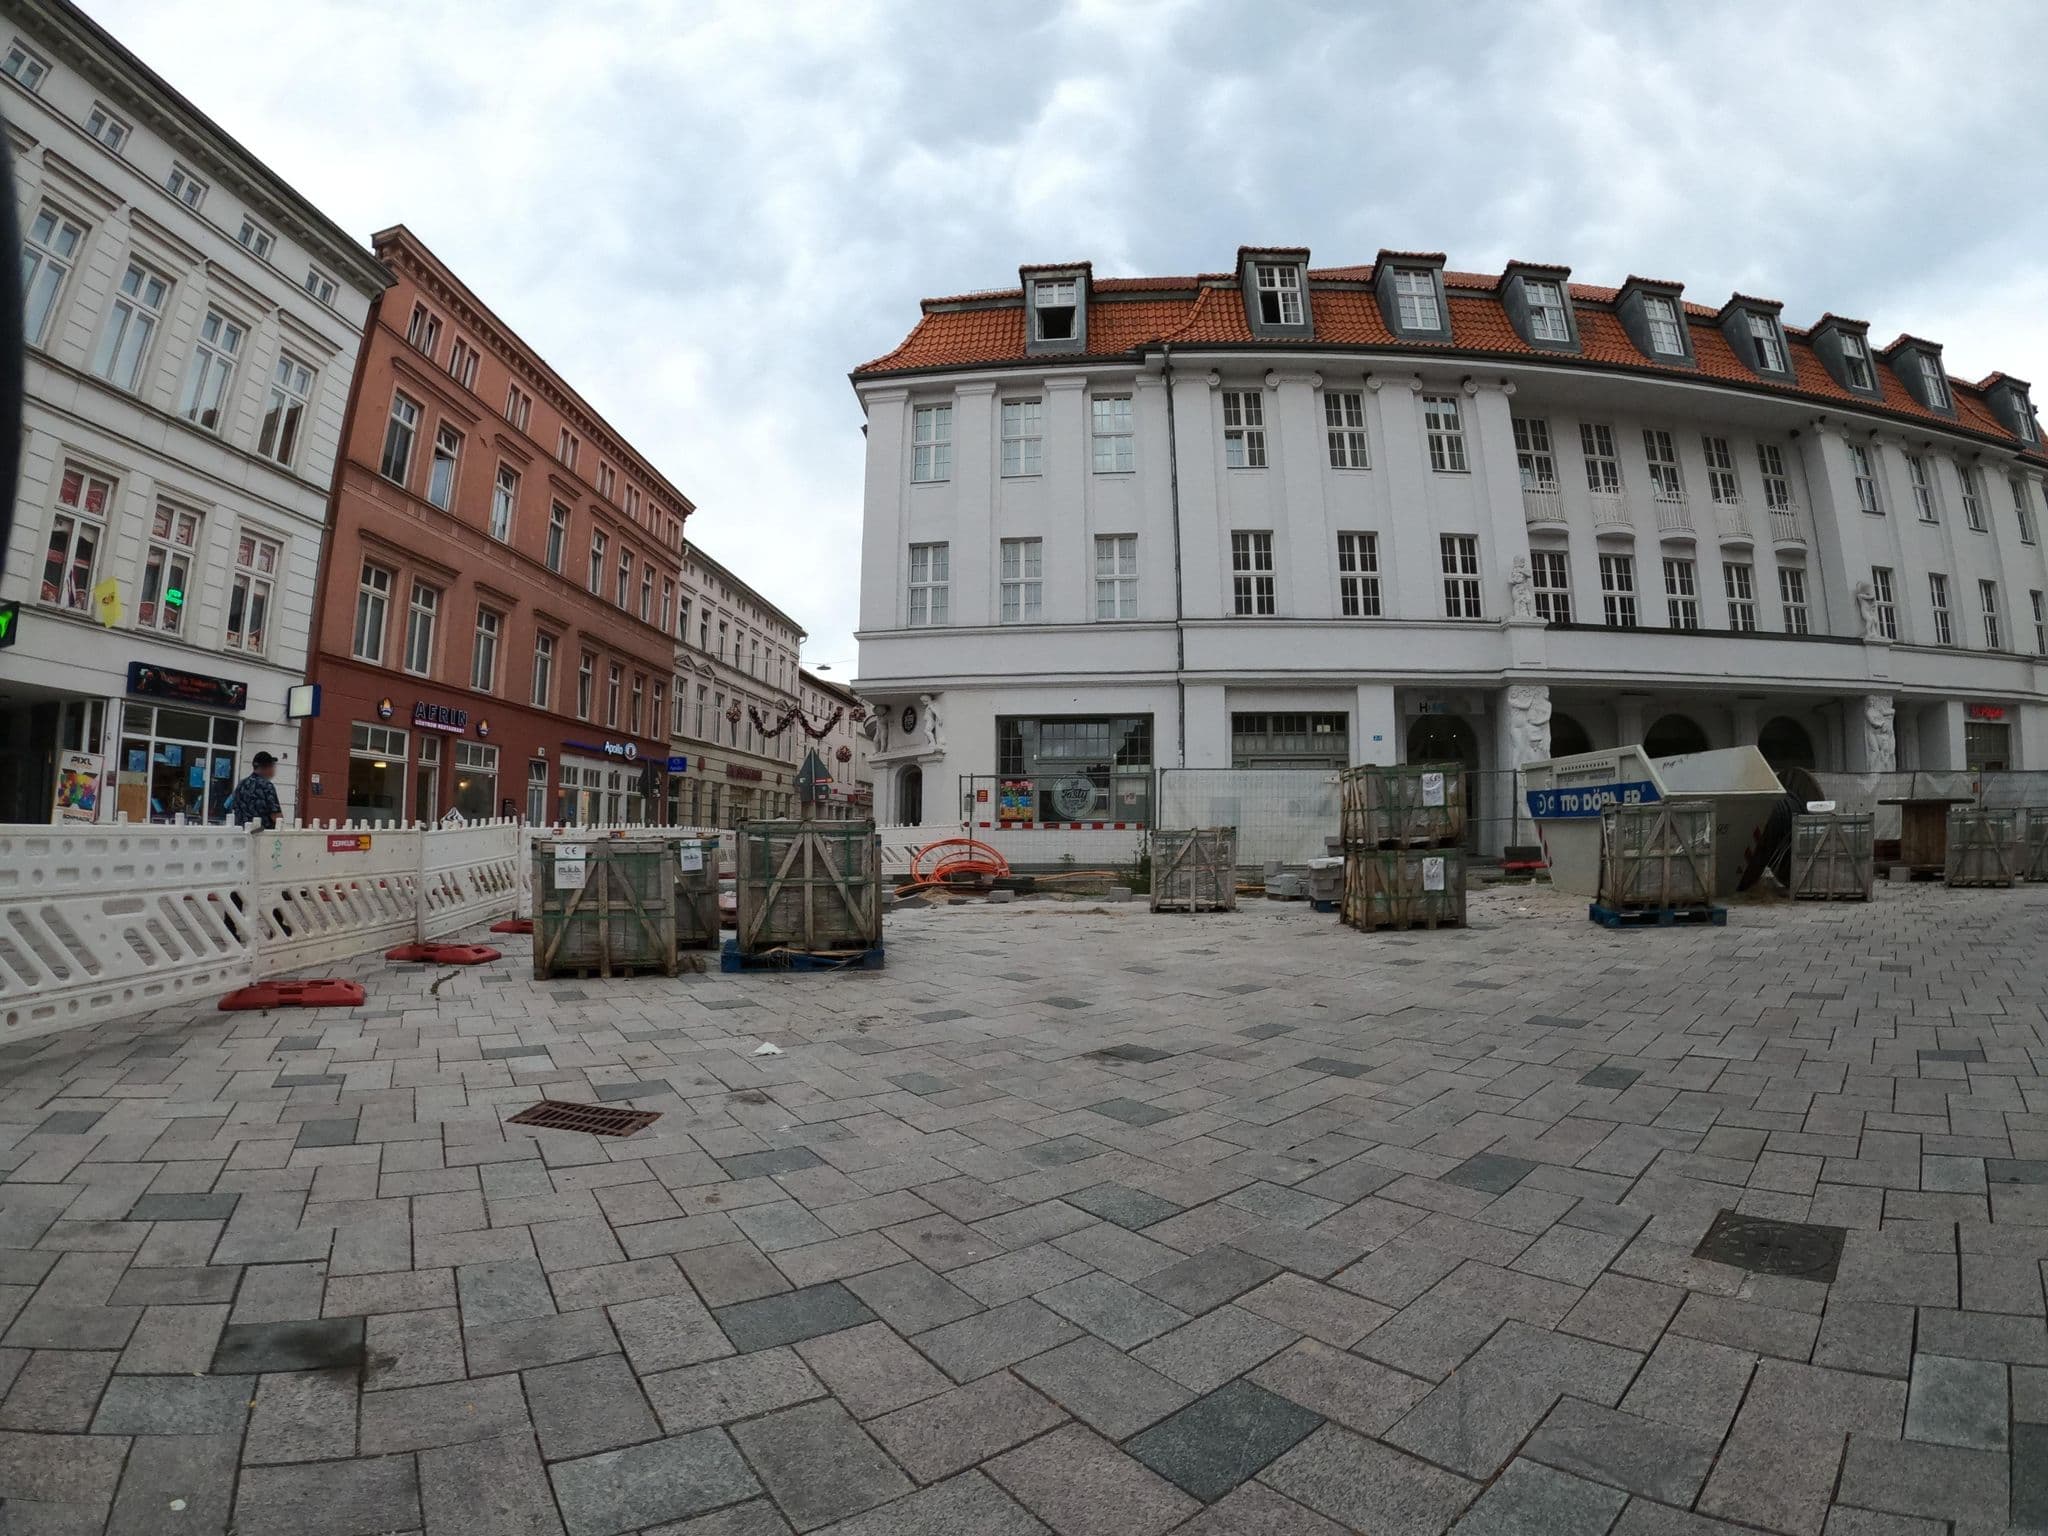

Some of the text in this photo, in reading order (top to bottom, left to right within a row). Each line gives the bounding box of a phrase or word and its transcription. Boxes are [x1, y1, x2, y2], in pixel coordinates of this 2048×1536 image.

[415, 700, 468, 727] AFRIN
[605, 741, 624, 755] Apollo
[71, 756, 93, 766] PIXL
[1061, 788, 1091, 802] Tasty
